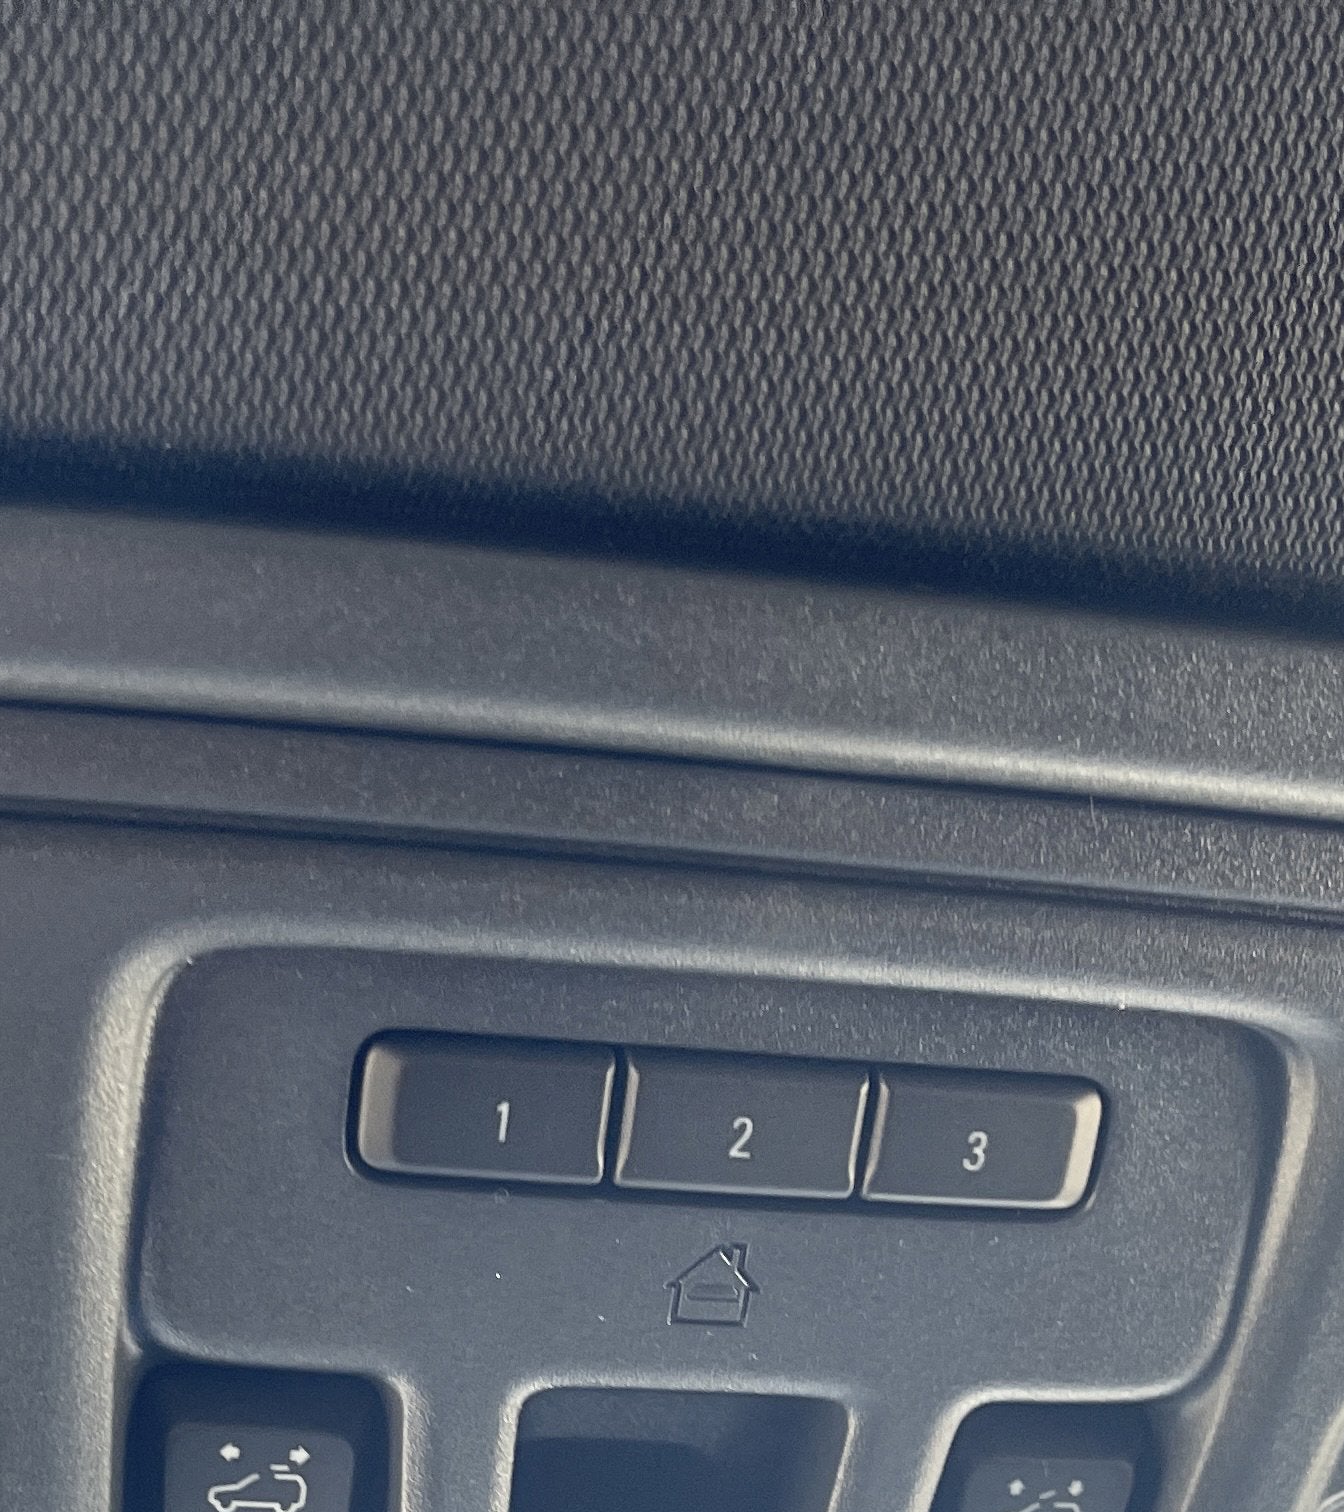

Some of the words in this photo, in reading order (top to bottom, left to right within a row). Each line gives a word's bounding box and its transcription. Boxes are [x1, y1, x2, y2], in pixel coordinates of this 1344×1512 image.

[495, 1102, 510, 1143] 1
[729, 1117, 753, 1158] 2
[962, 1131, 988, 1172] 3
